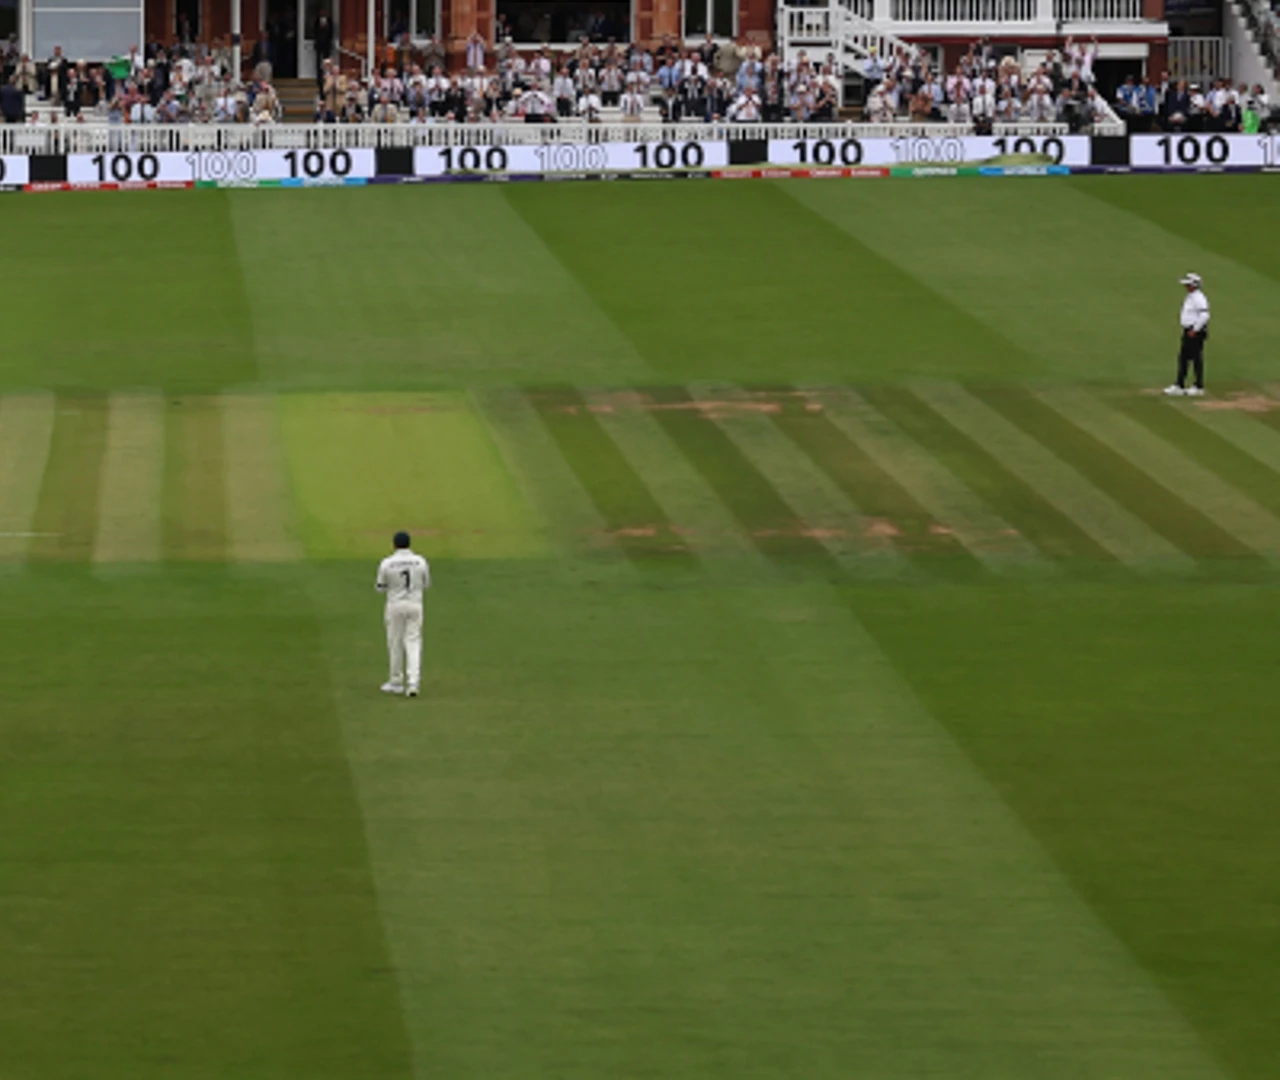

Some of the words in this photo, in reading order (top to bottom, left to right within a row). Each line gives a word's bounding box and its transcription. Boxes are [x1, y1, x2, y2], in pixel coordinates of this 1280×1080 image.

[438, 146, 508, 172] 100
[633, 141, 705, 169] 100
[792, 139, 863, 166] 100
[1157, 135, 1230, 164] 100
[91, 153, 160, 182] 100
[284, 150, 353, 178] 100
